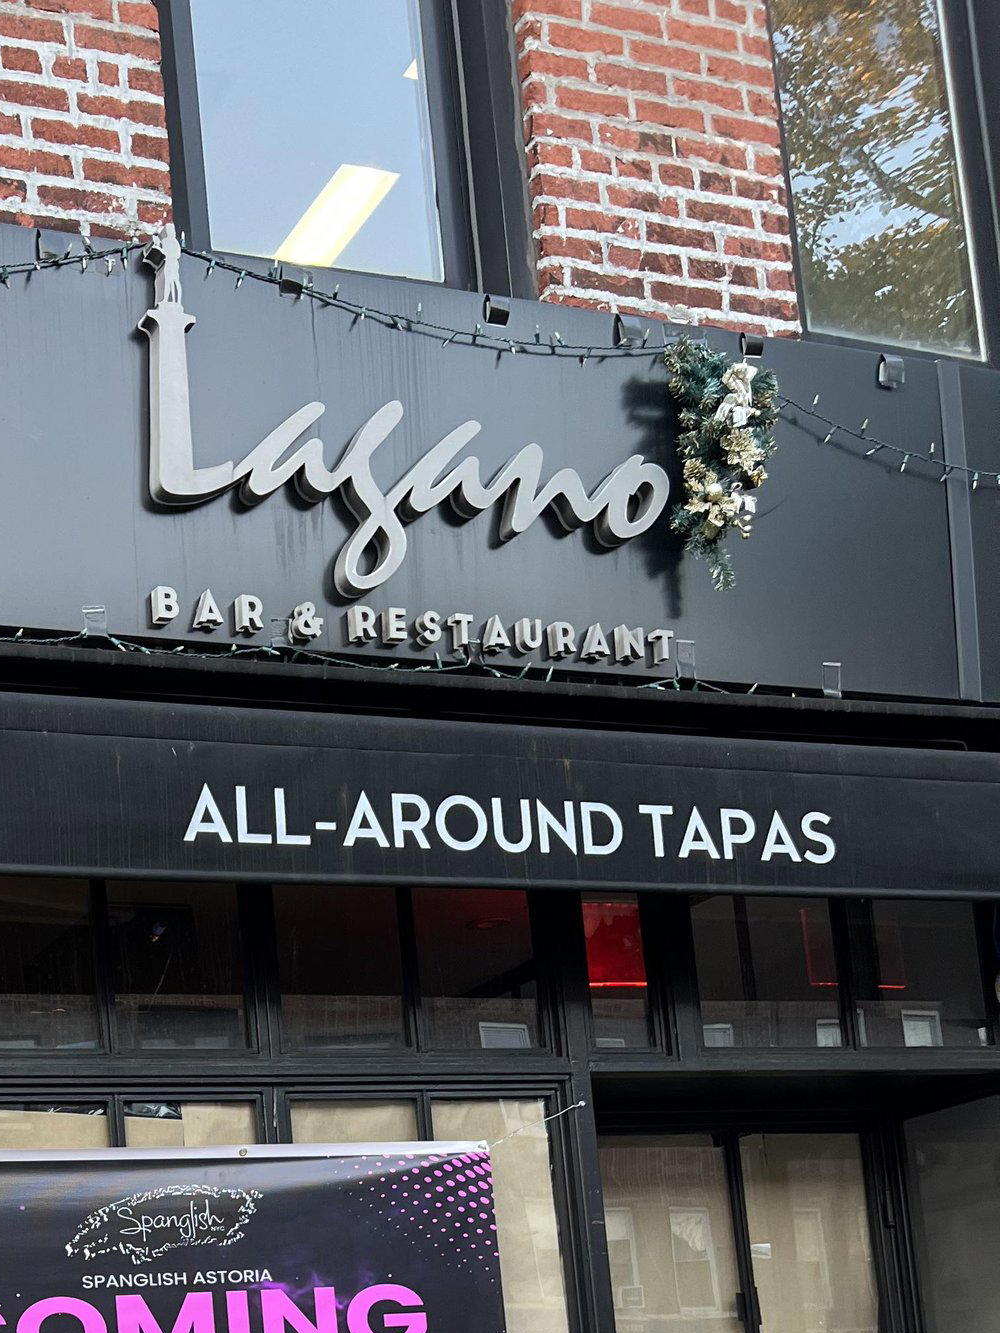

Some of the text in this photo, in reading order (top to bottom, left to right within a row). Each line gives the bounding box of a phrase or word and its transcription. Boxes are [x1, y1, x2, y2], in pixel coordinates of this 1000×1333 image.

[150, 585, 674, 665] BAR & RESTAURANT
[183, 783, 836, 864] ALL-AROUND TAPAS
[117, 1199, 224, 1242] Spanglish
[82, 1268, 272, 1290] SPANGLISH ASTORIA
